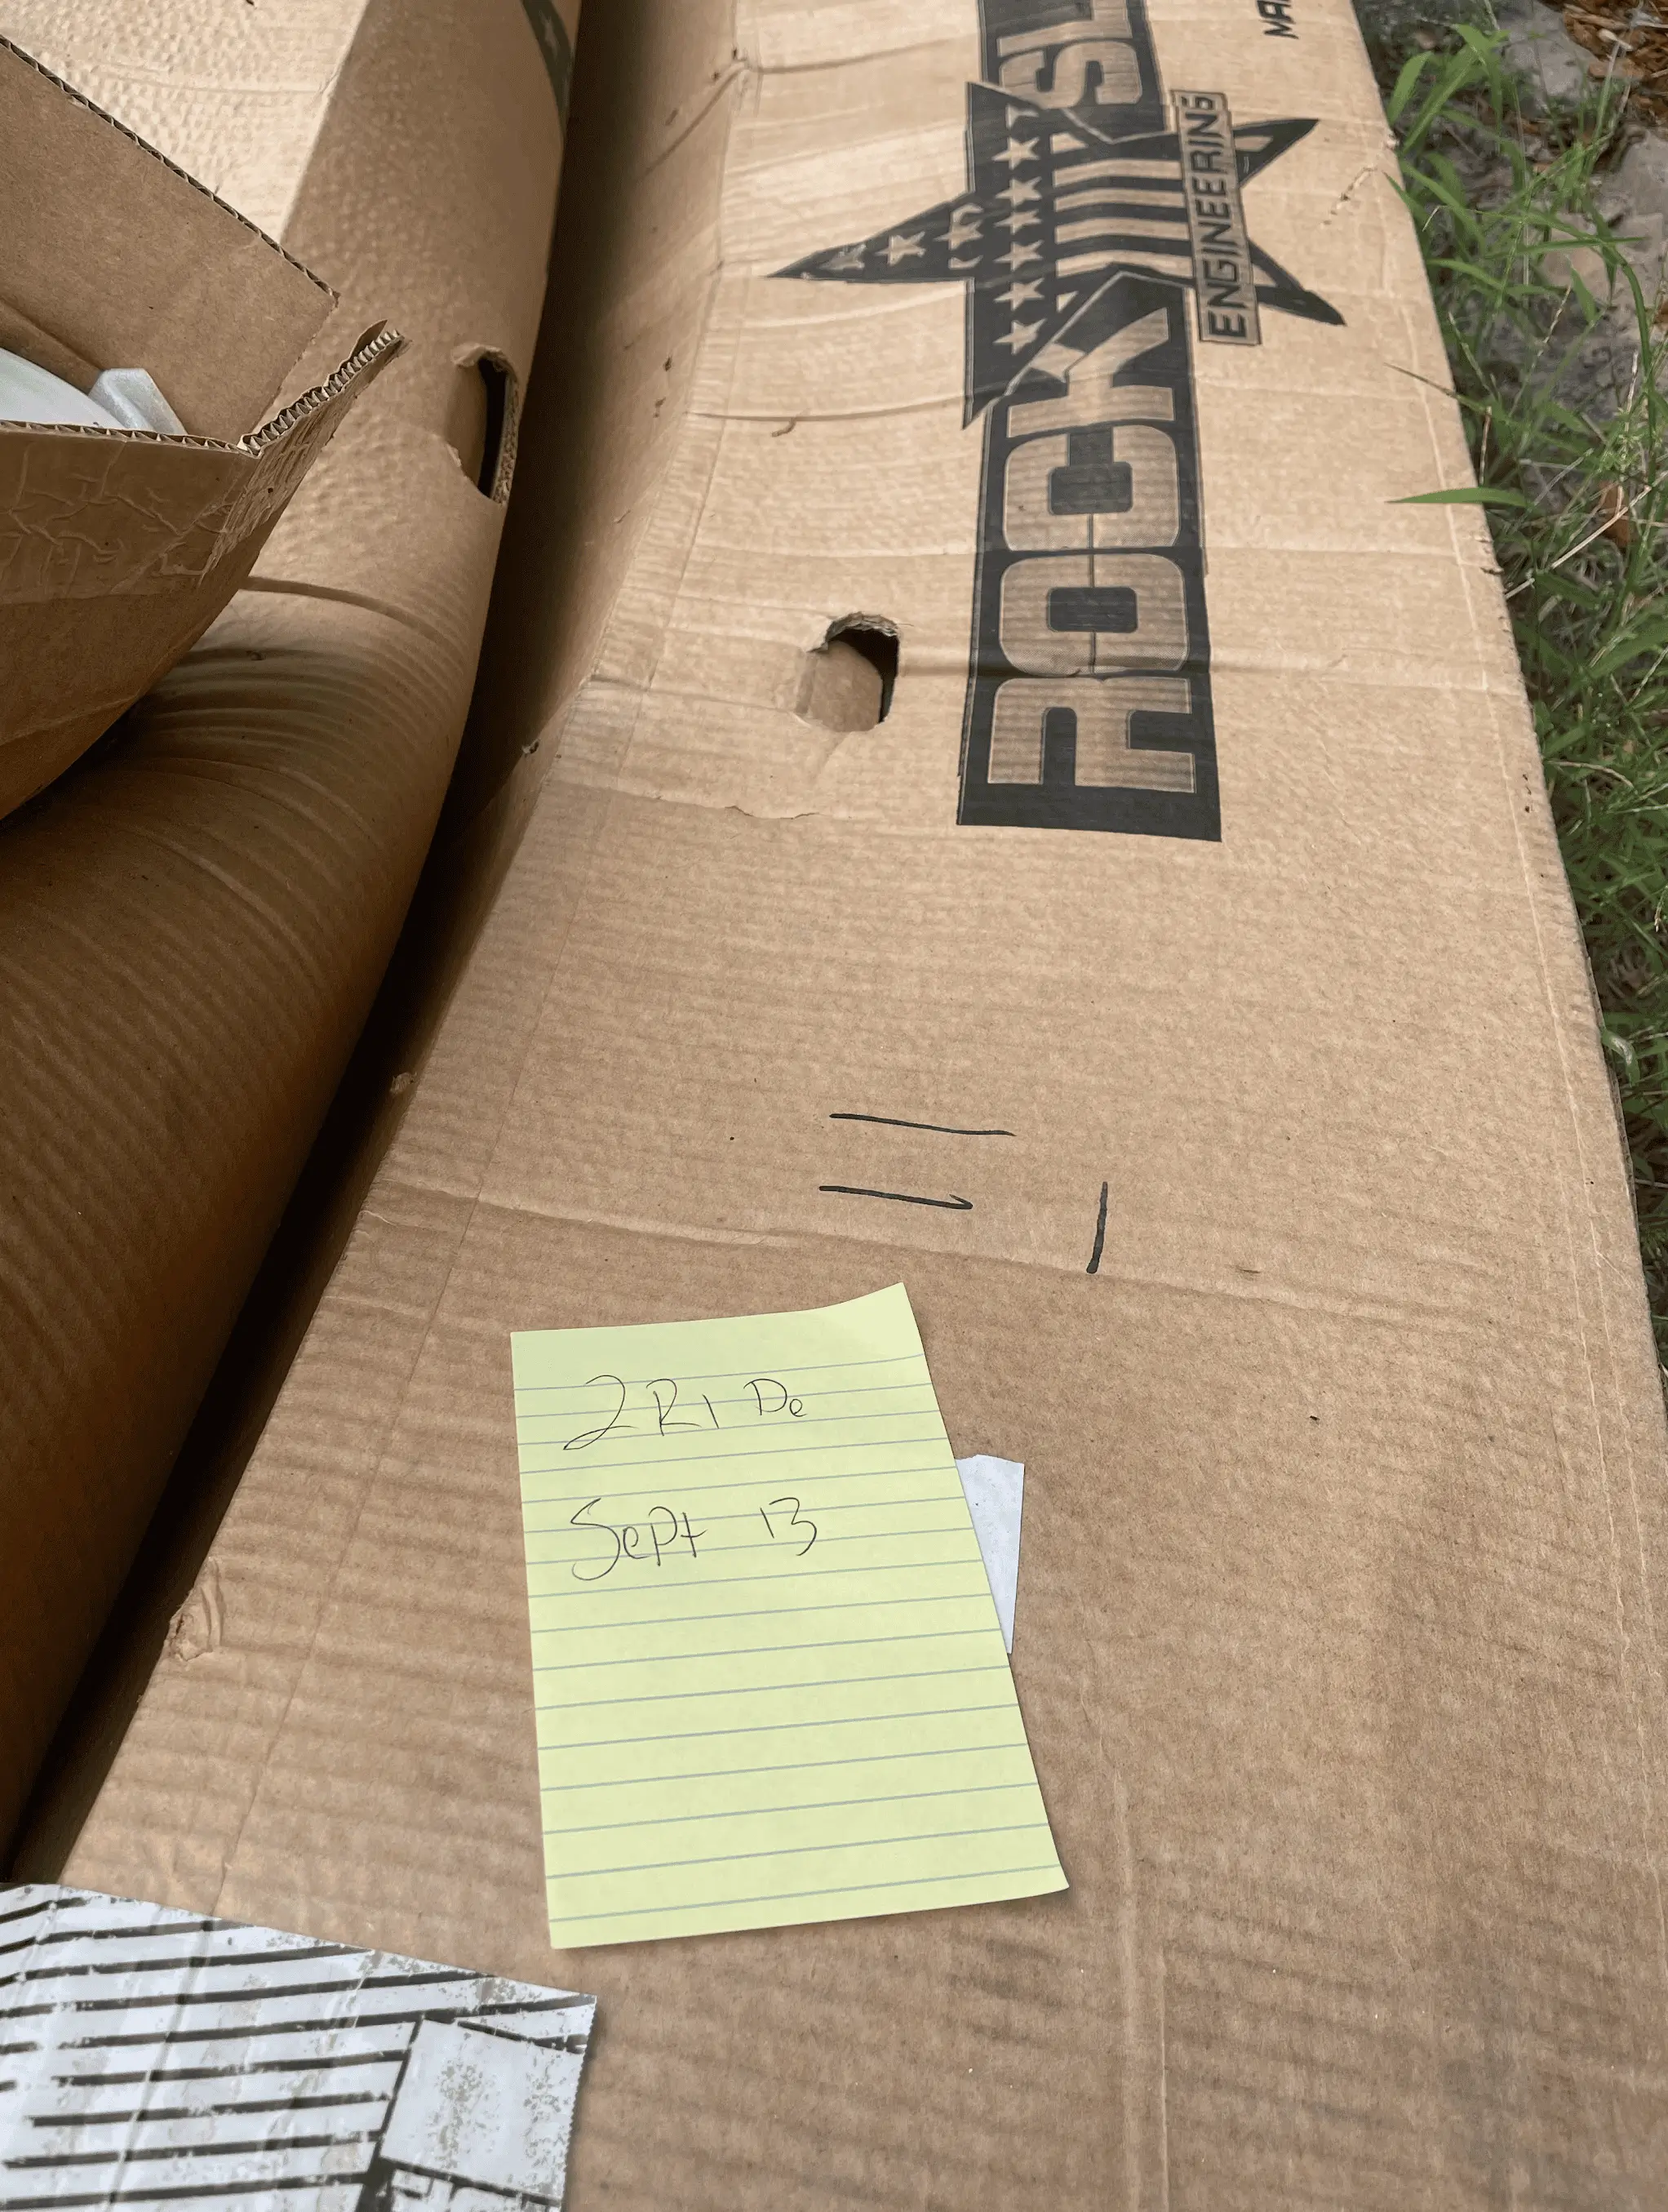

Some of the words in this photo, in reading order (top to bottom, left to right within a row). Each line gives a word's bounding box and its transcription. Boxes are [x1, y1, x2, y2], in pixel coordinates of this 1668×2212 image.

[1179, 93, 1248, 340] ENGINEERING
[987, 305, 1197, 794] ROCK
[759, 1496, 818, 1557] 13
